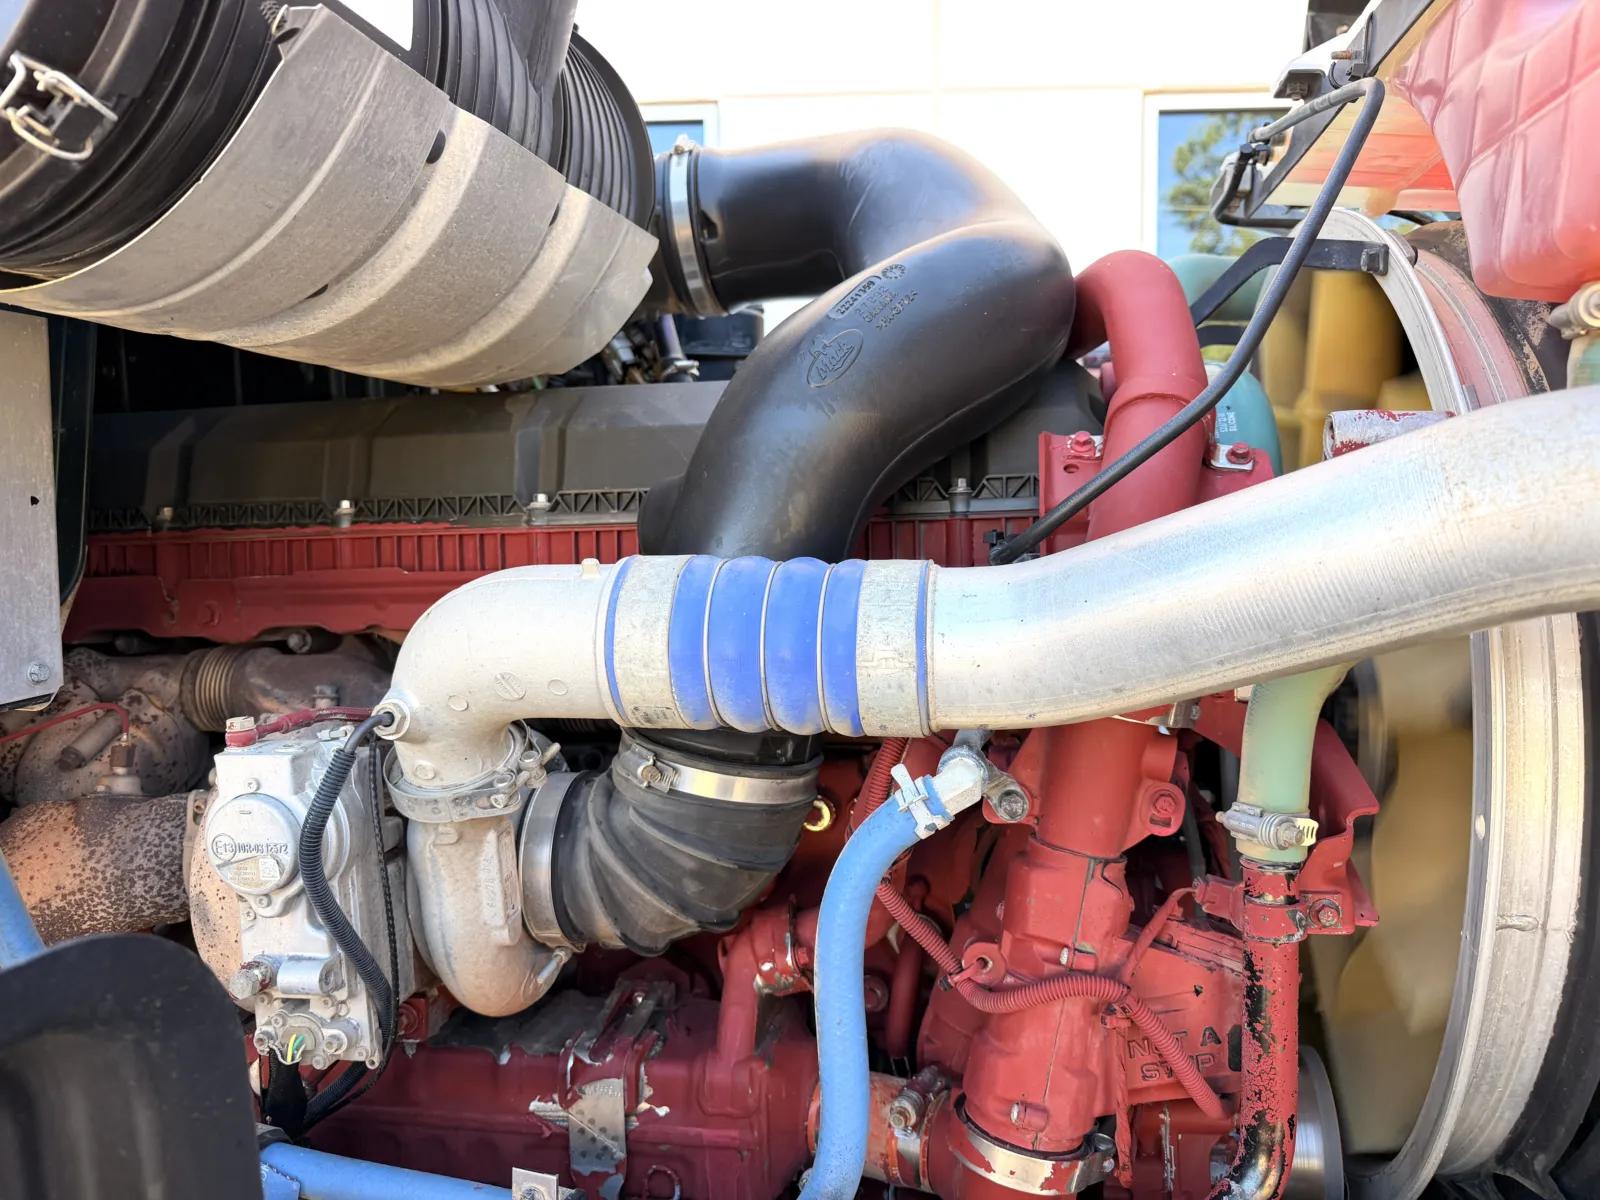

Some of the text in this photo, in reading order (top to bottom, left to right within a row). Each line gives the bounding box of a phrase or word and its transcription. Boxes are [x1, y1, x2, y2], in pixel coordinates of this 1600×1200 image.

[1127, 1026, 1222, 1059] NT A
[1141, 1053, 1215, 1081] STP
